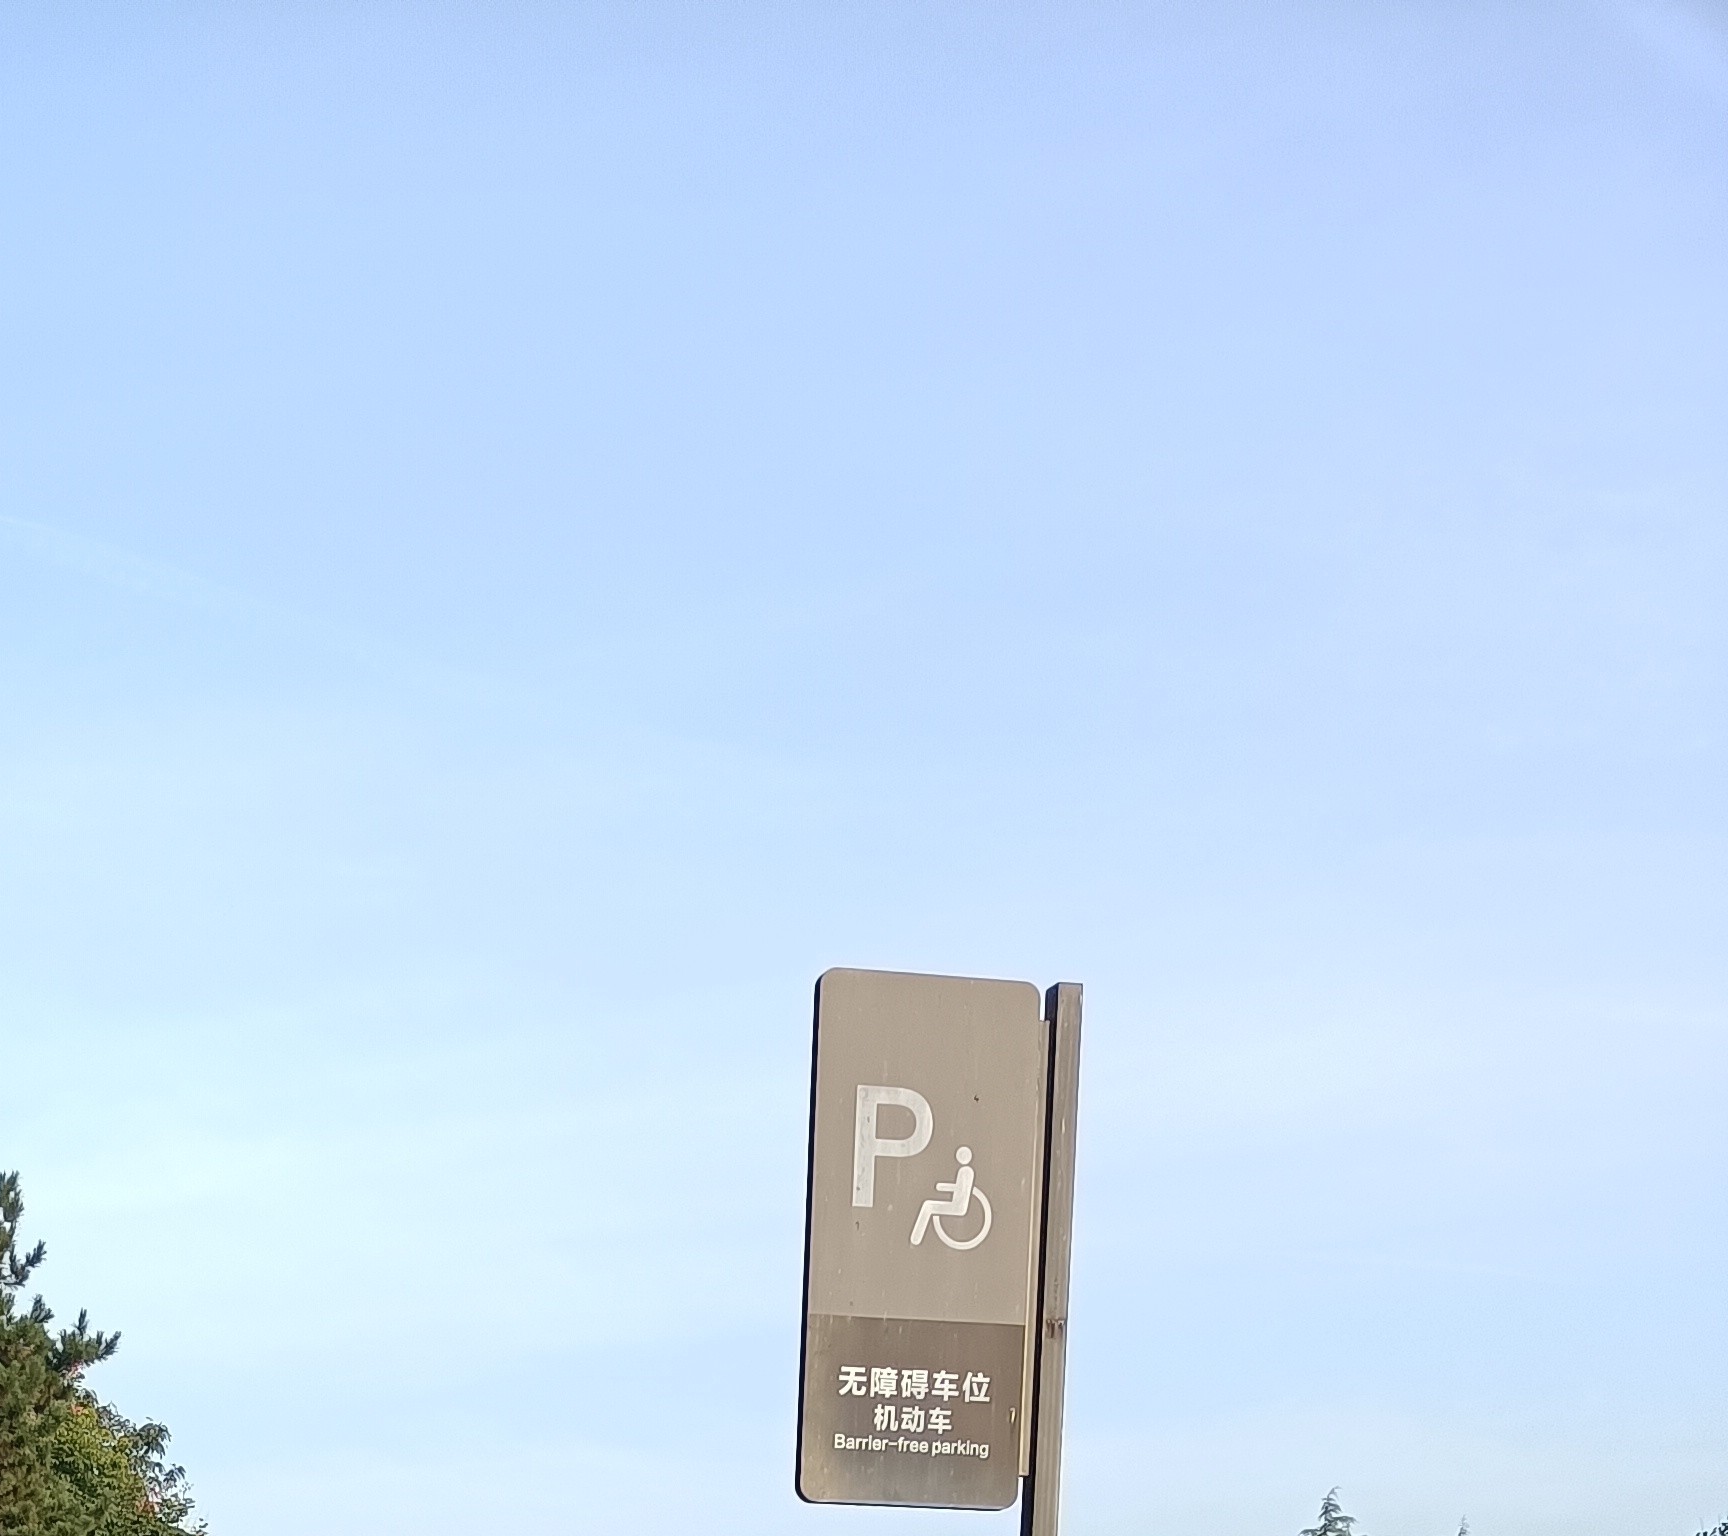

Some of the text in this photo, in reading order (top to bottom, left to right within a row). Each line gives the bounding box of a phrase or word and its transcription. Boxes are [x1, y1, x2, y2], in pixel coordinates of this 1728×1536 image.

[852, 1084, 933, 1208] P
[838, 1366, 991, 1403] 无障碍车位
[873, 1404, 952, 1434] 机动车
[834, 1434, 989, 1459] Barrier-free parking
